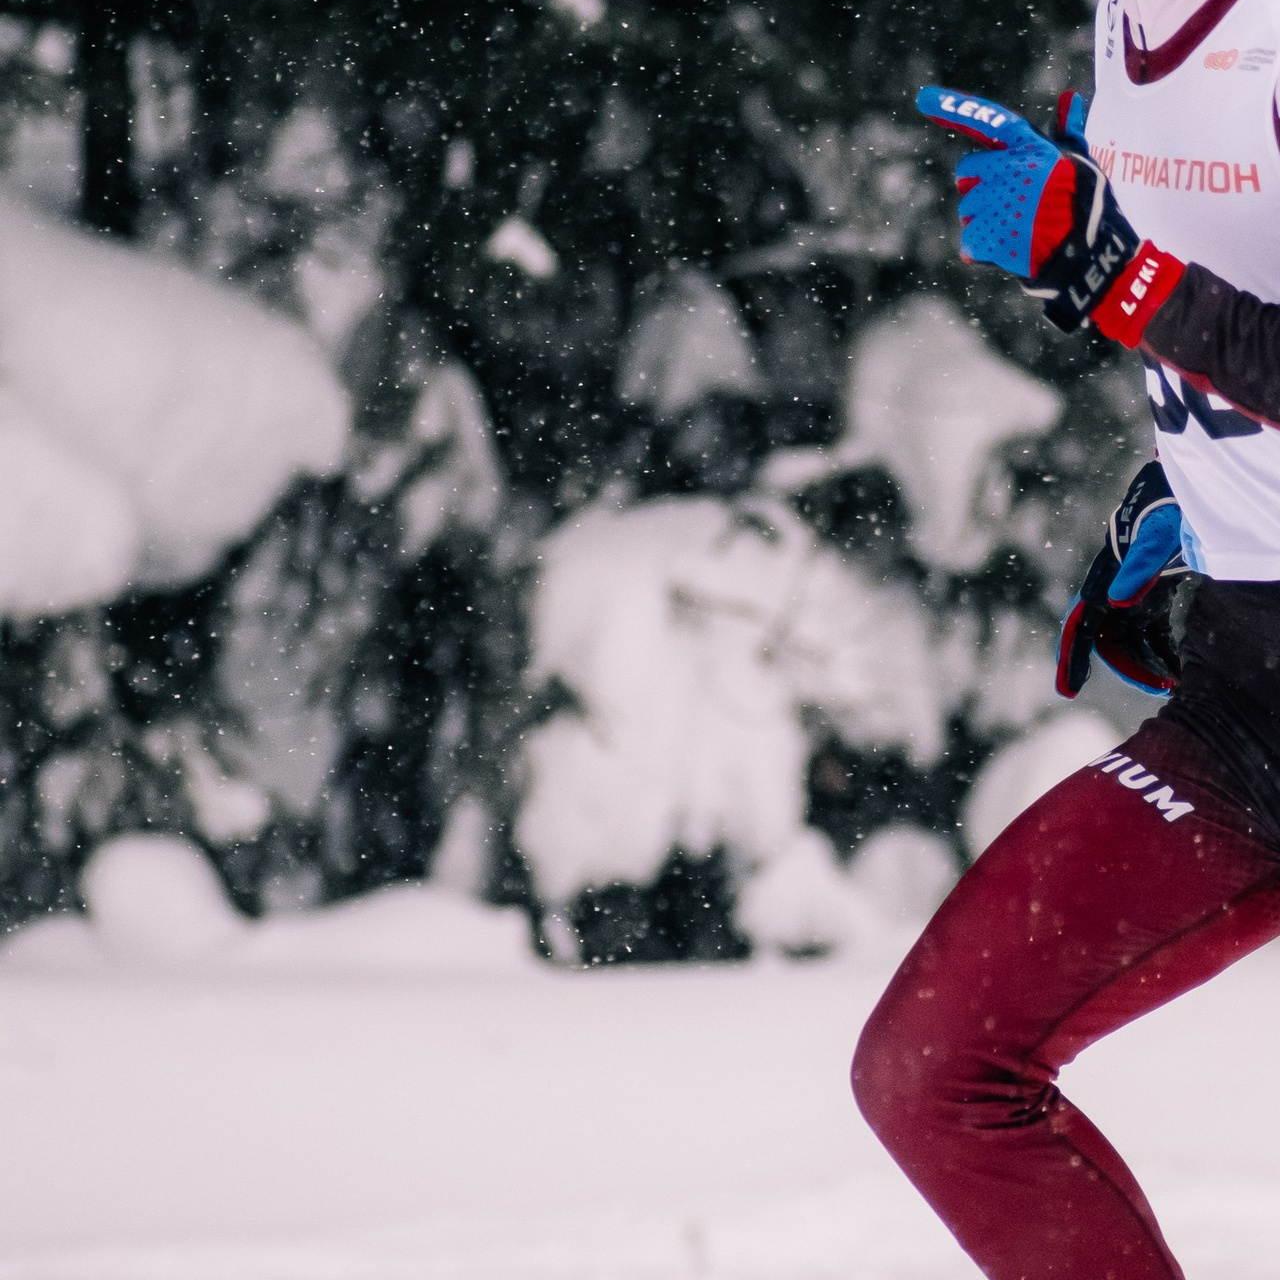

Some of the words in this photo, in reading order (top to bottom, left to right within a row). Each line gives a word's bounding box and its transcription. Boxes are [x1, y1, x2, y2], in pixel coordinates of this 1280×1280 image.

[940, 96, 1006, 128] LEKI
[1121, 151, 1261, 193] ТРИАТЛОН
[1068, 233, 1125, 311] LEKI
[1120, 257, 1159, 316] LEKI
